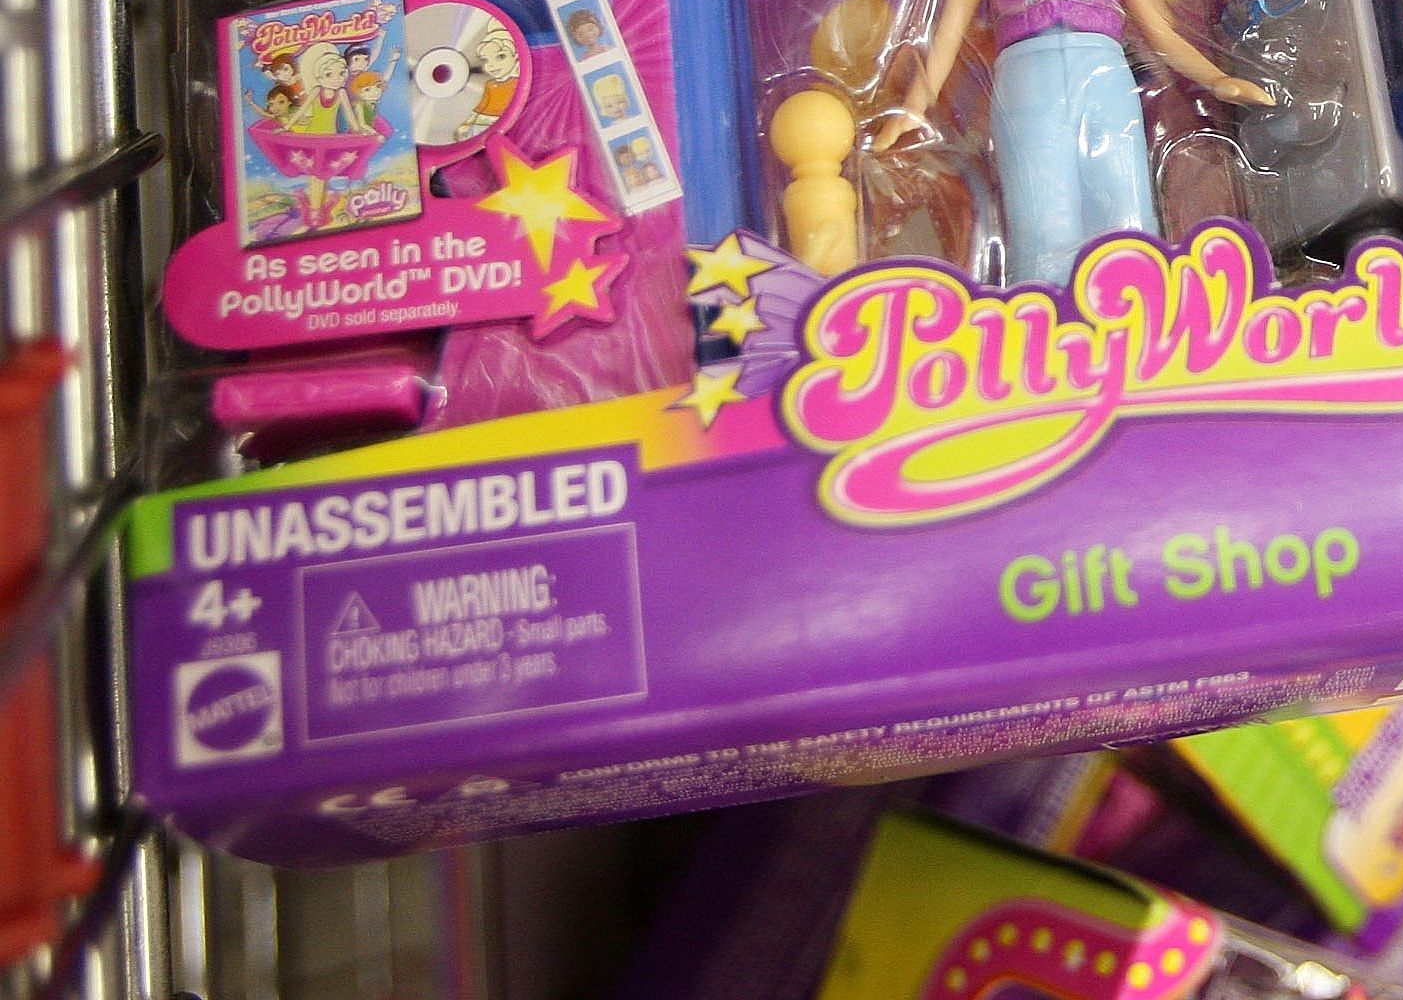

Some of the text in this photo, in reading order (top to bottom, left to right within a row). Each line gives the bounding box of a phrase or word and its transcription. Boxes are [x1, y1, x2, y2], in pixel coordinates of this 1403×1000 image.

[245, 231, 487, 281] As seen in the
[441, 260, 522, 294] DVD!
[308, 312, 340, 330] DVD
[344, 308, 377, 326] sold
[187, 459, 630, 571] UNASSEMBLED
[411, 563, 557, 625] WARNING:
[1002, 525, 1361, 621] Gift Shop
[188, 579, 263, 630] 4+
[328, 629, 421, 673] CHOKING
[421, 617, 504, 658] HAZARD
[797, 725, 887, 749] SAFETY
[893, 697, 1080, 733] REQUIREMENTS
[1086, 689, 1119, 705] OF
[1123, 680, 1190, 702] ASTM
